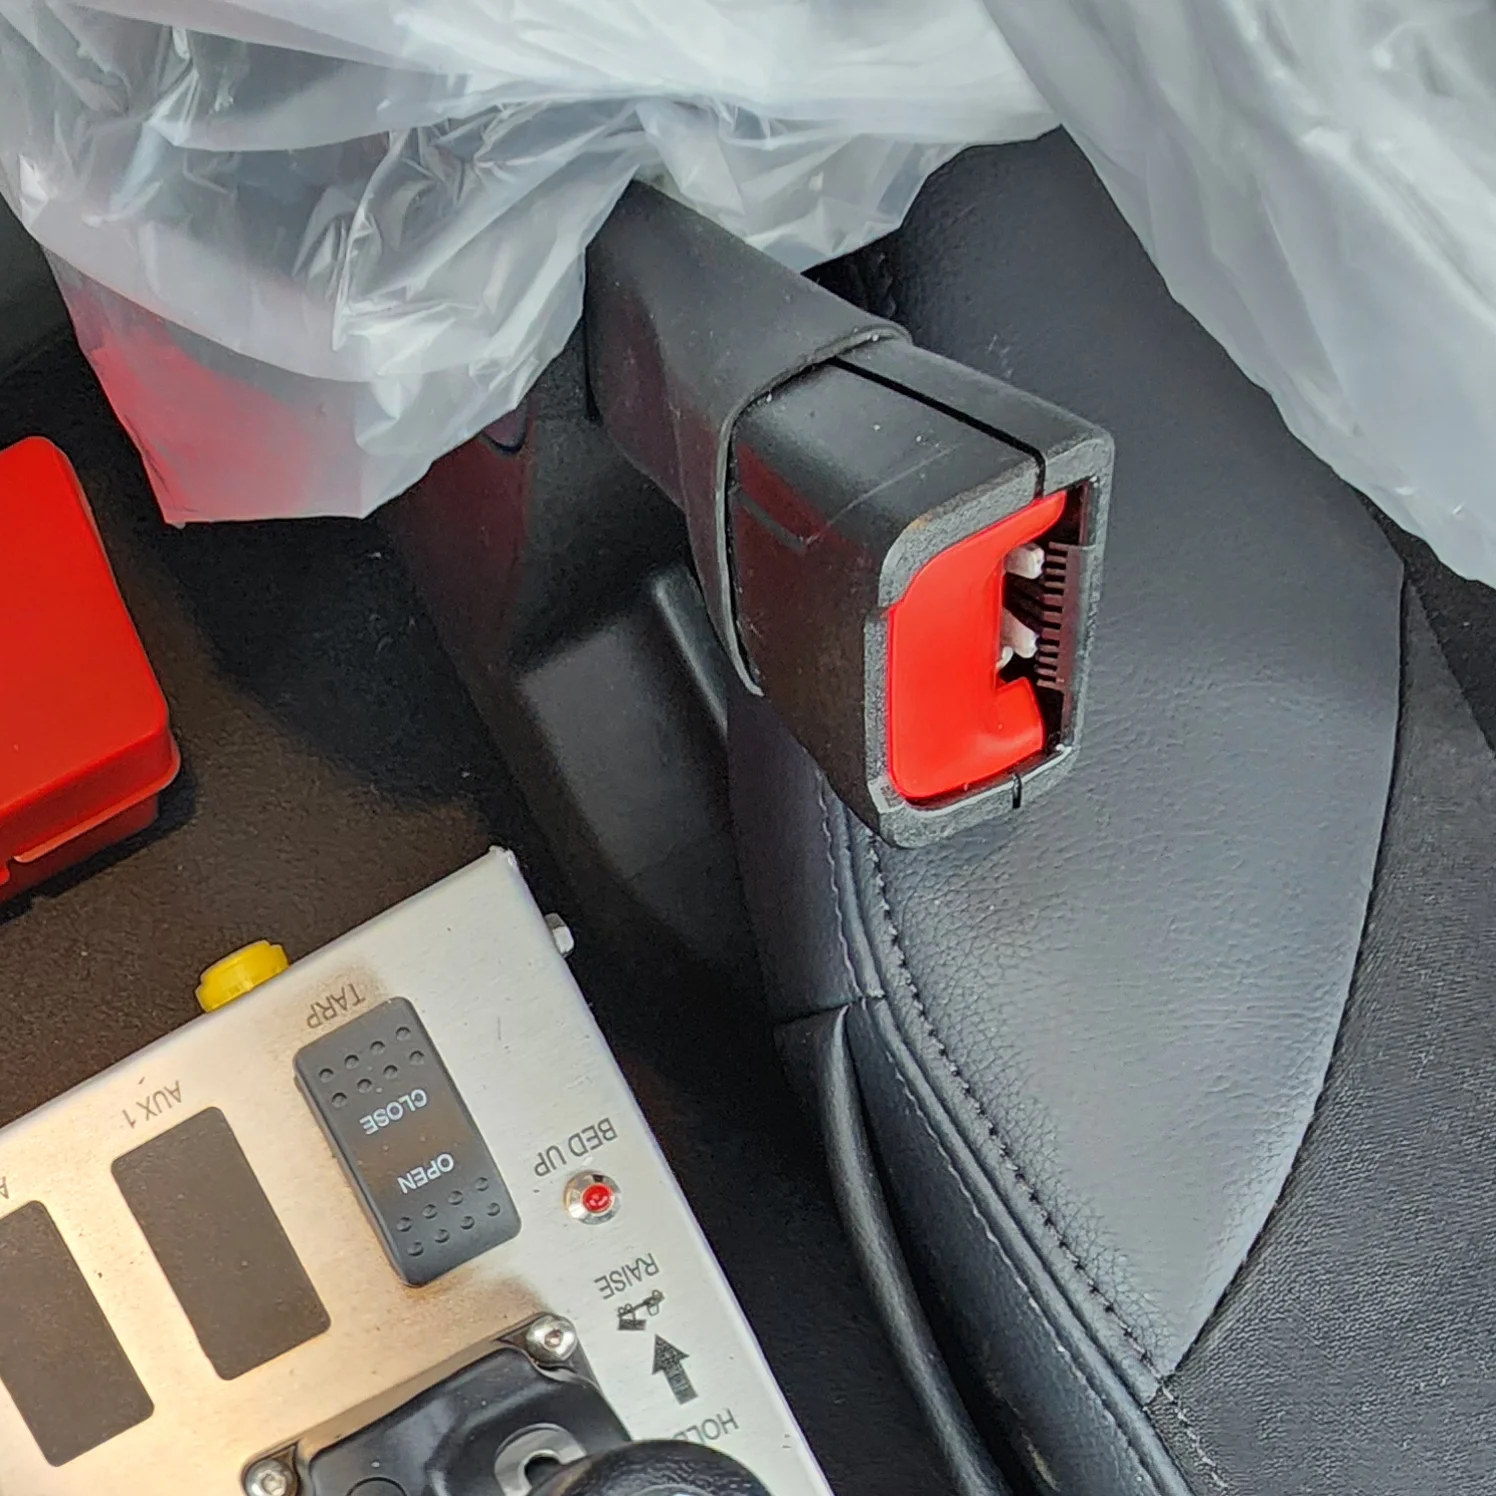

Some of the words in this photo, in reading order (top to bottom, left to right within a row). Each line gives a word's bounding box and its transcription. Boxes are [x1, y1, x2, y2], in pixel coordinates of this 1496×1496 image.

[307, 985, 365, 1029] TARP
[122, 1109, 137, 1129] 1
[136, 1080, 182, 1121] AUX
[359, 1089, 427, 1135] CLOSE
[568, 1117, 618, 1156] BED
[397, 1153, 454, 1194] OPEN
[534, 1144, 567, 1177] UP
[594, 1253, 660, 1300] RAISE
